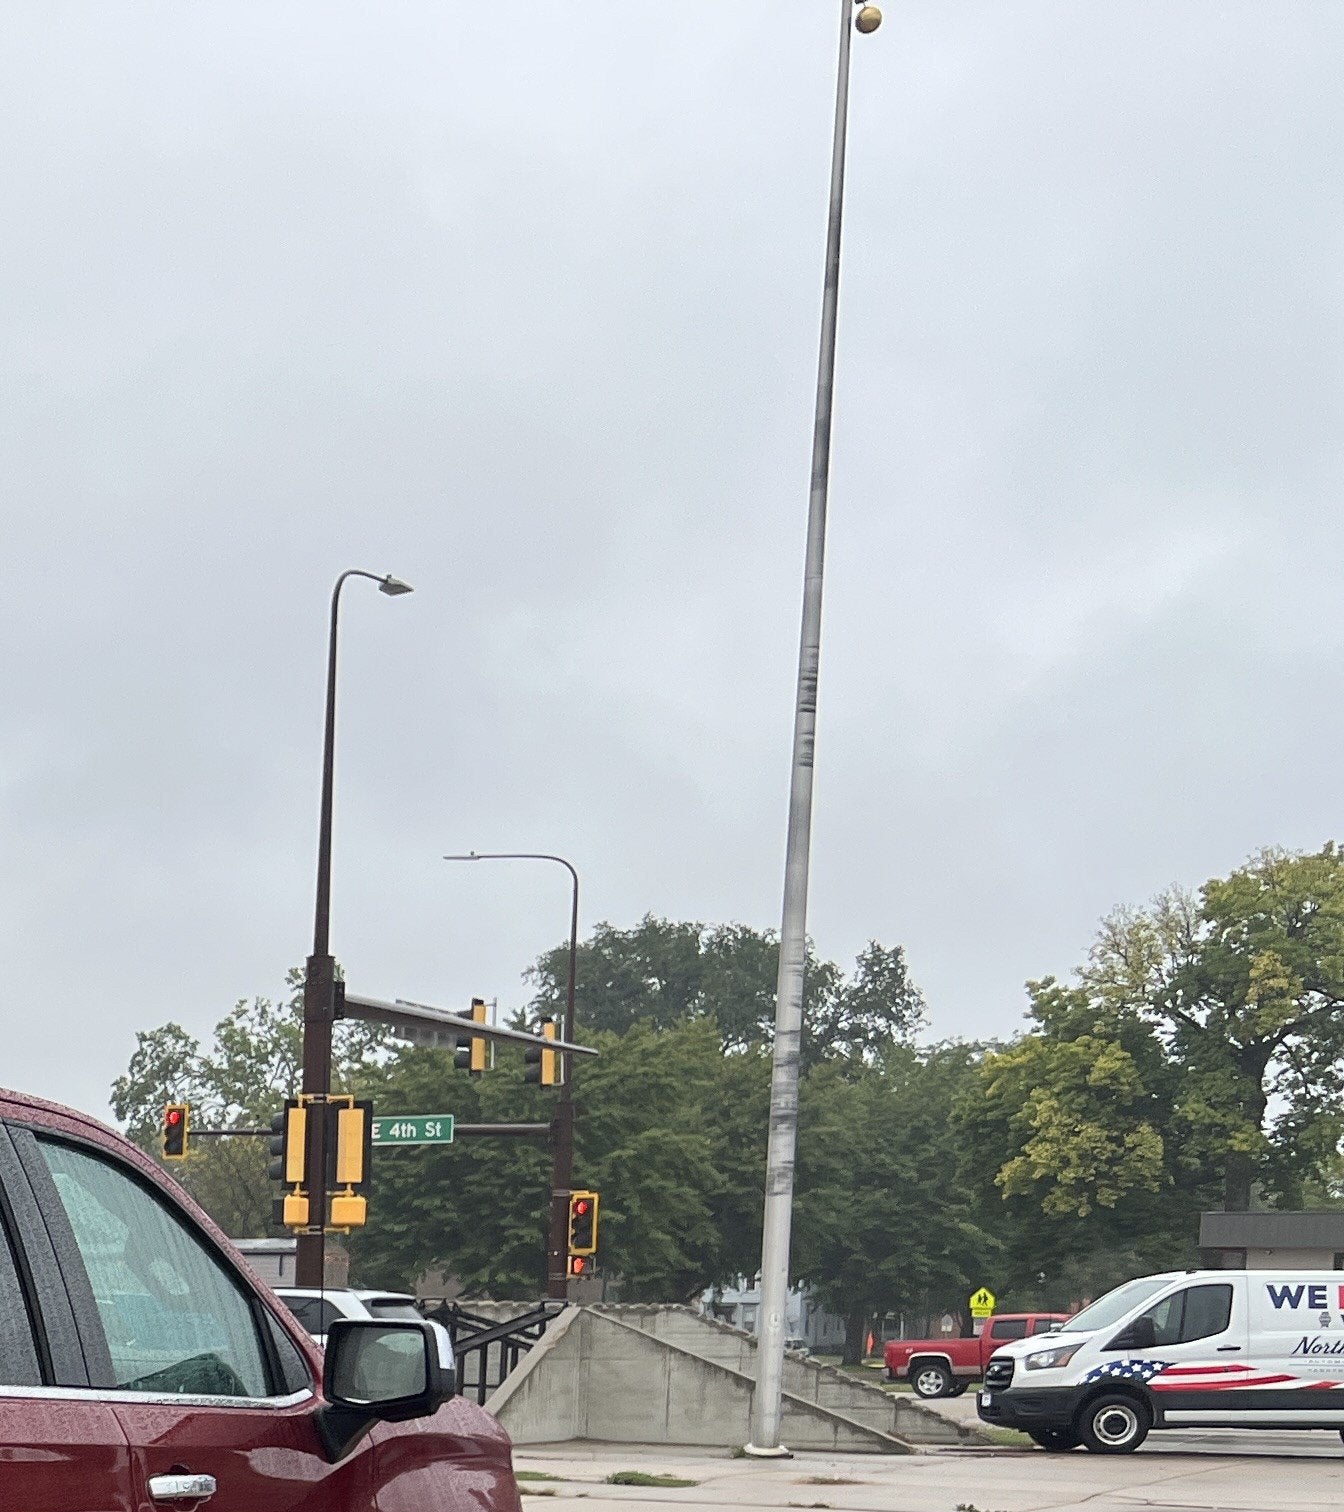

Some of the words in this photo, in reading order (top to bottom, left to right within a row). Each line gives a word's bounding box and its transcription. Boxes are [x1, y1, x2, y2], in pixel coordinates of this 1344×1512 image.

[372, 1123, 381, 1139] E
[389, 1122, 416, 1138] 4th
[425, 1121, 442, 1137] St
[1266, 1284, 1328, 1310] WE
